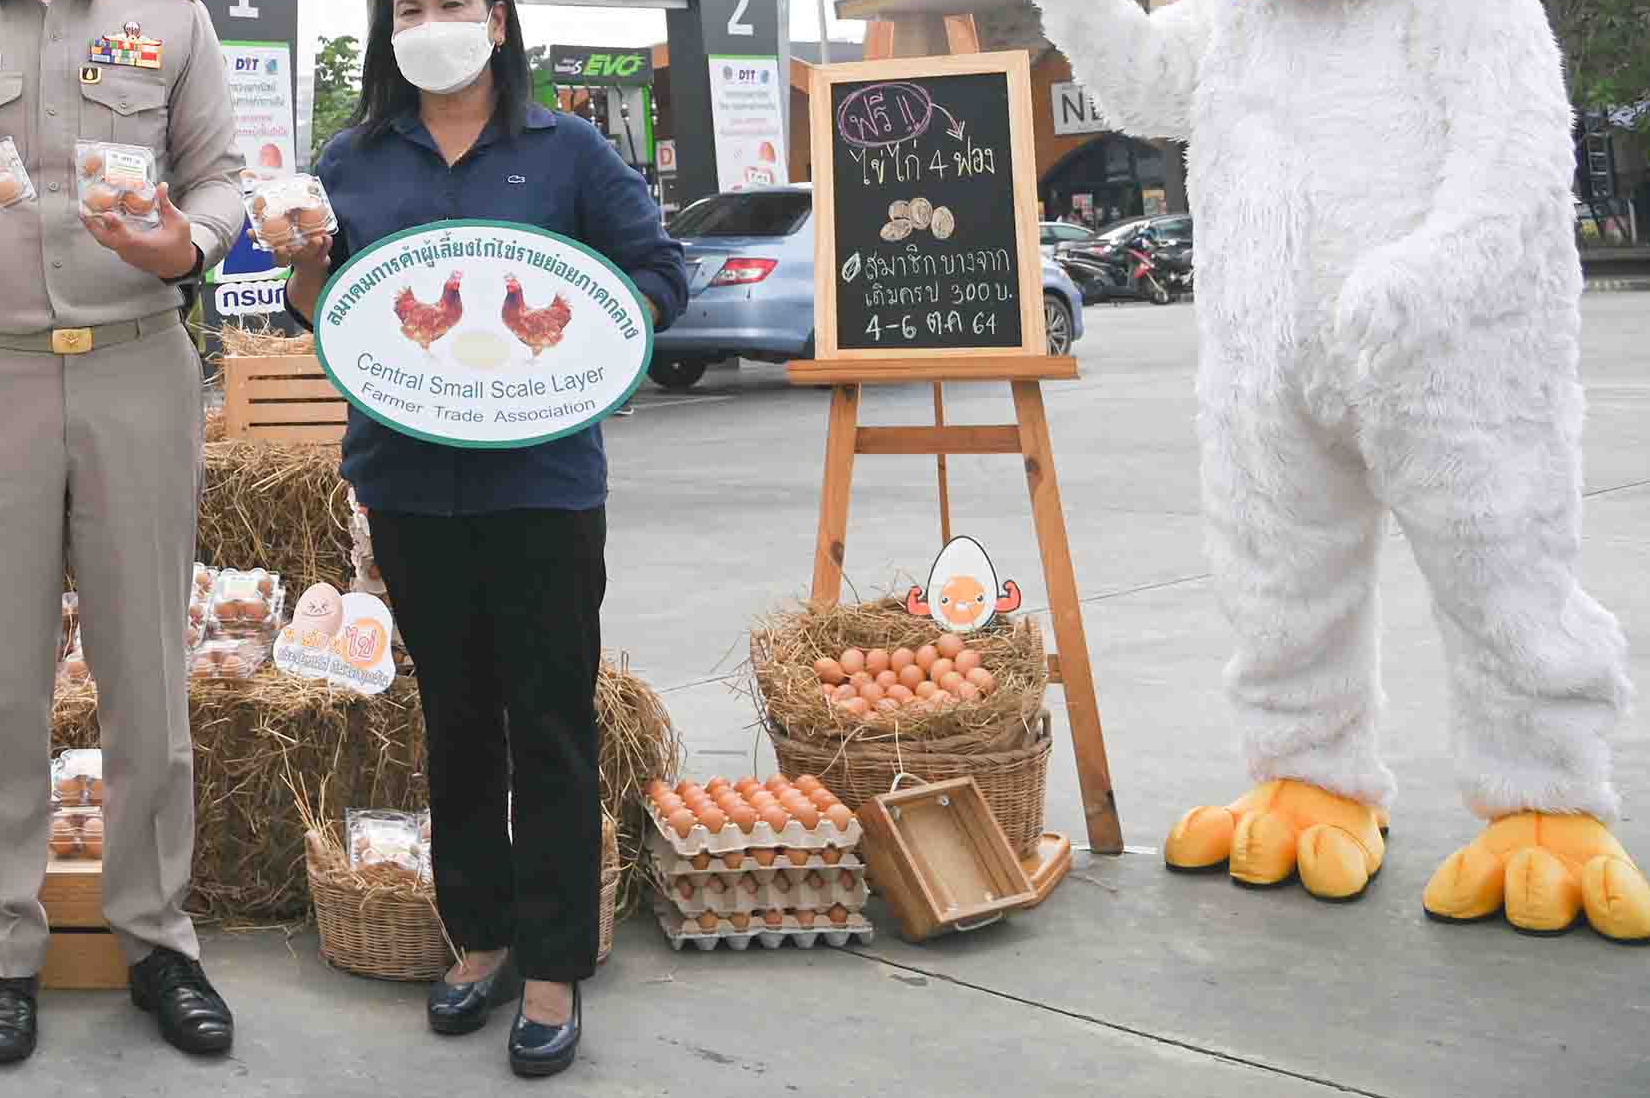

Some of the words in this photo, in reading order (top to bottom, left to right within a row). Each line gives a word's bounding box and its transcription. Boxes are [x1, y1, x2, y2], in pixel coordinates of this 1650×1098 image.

[849, 139, 921, 185] ไข่ไก่
[928, 149, 949, 179] 4
[953, 137, 995, 176] ฟอง
[327, 230, 639, 341] สมาคมการค้าผู้เลี้ยงไก่ไข่รายย่อยภาคกลาง
[950, 282, 989, 305] 300
[972, 311, 997, 335] 64
[356, 352, 423, 392] Central
[429, 374, 484, 400] Small
[491, 374, 547, 400] Scale
[551, 363, 606, 395] Layer
[360, 381, 424, 416] Farmer
[433, 404, 485, 423] Trade
[493, 398, 597, 424] Association
